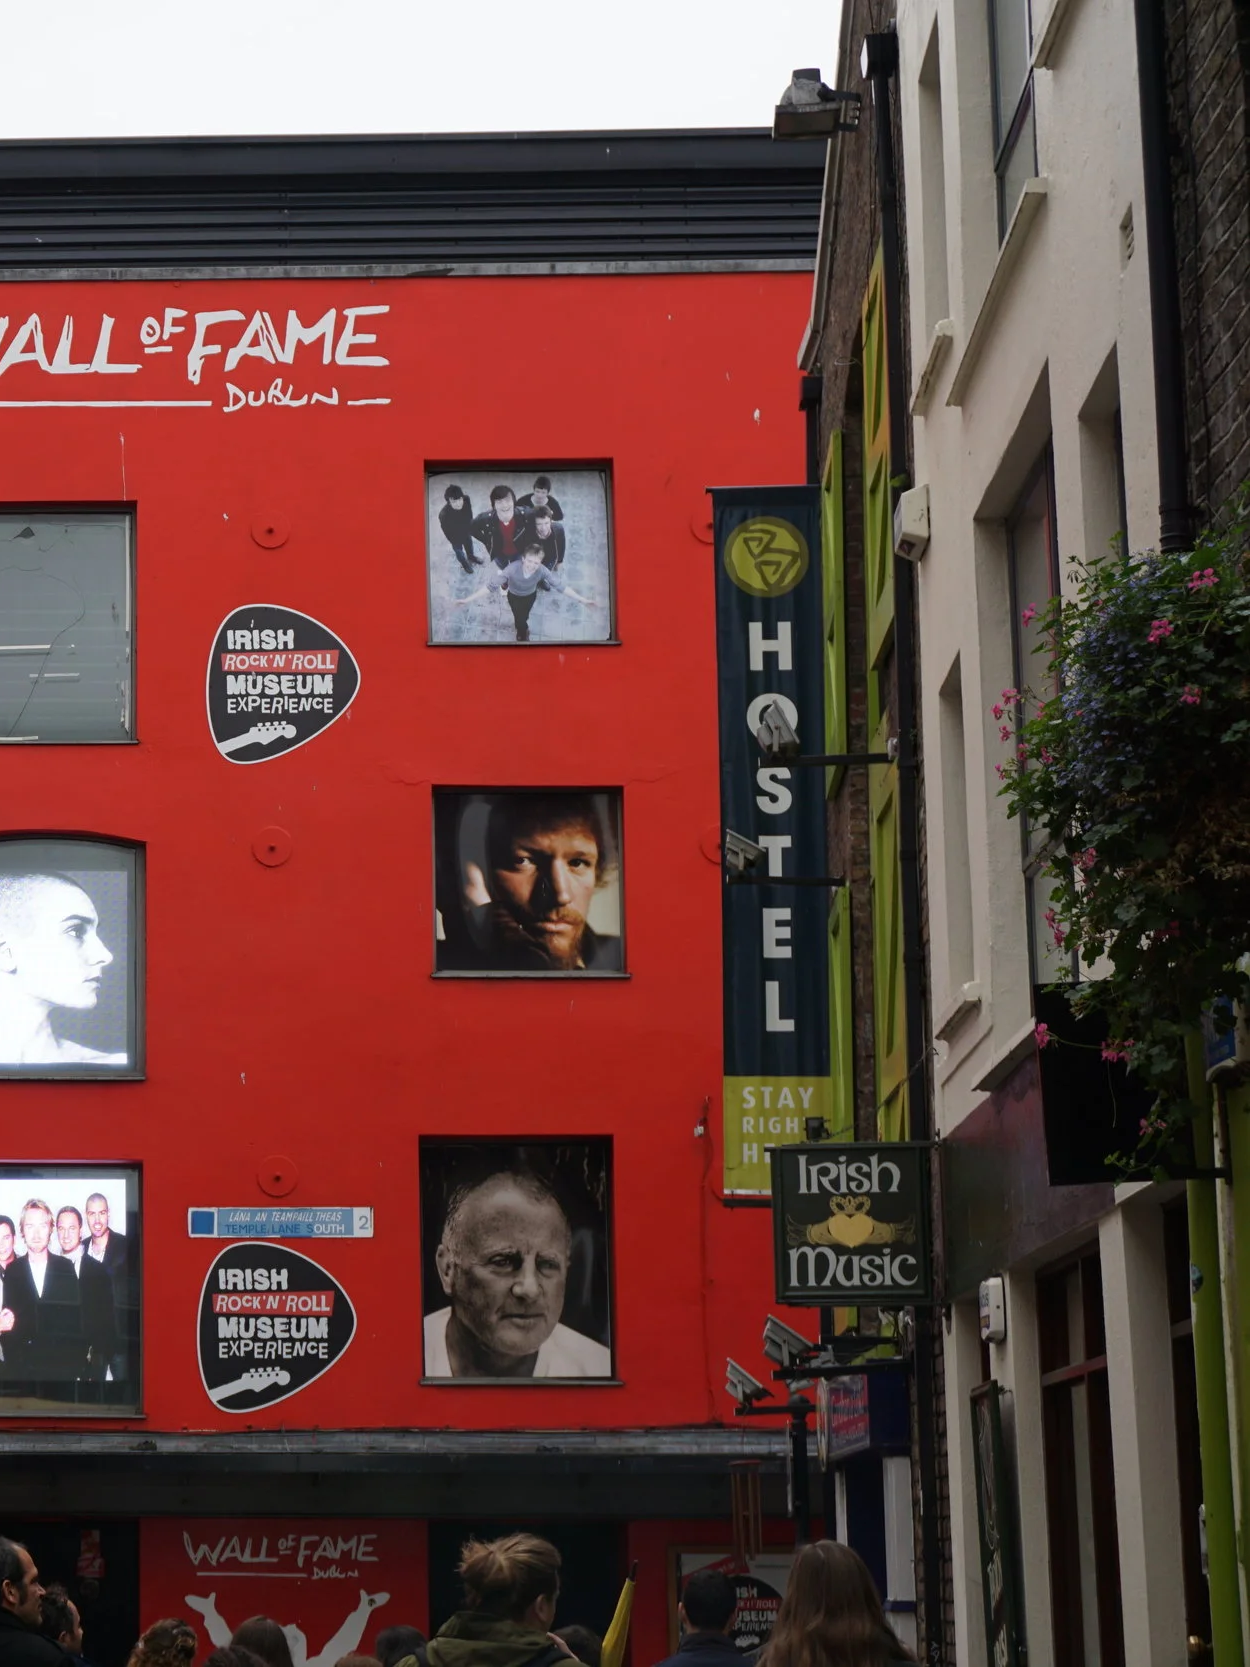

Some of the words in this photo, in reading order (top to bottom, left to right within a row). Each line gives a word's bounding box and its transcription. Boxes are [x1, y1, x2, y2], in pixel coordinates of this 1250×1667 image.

[140, 307, 188, 354] OF
[187, 304, 390, 386] FAME
[226, 628, 295, 650] IRISH
[226, 674, 334, 695] MUSEUM
[227, 695, 334, 715] EXPERIENCE
[746, 621, 799, 1032] HOSTEL
[742, 1086, 814, 1109] STAY
[742, 1116, 806, 1134] RIGH
[797, 1153, 902, 1195] Irish
[228, 1210, 251, 1224] LÁNA
[254, 1212, 267, 1222] AN
[314, 1211, 343, 1223] THEAS
[358, 1215, 369, 1230] 2
[225, 1224, 267, 1235] TEMPLE
[271, 1224, 301, 1235] LANE
[306, 1223, 345, 1235] SOUTH
[788, 1246, 919, 1287] Music
[218, 1268, 289, 1291] IRISH
[218, 1316, 329, 1339] MUSEUM
[218, 1339, 329, 1360] EXPERIENCE
[183, 1530, 279, 1567] WALL
[278, 1534, 297, 1554] OF
[297, 1533, 380, 1568] FAME
[736, 1586, 758, 1598] ISH
